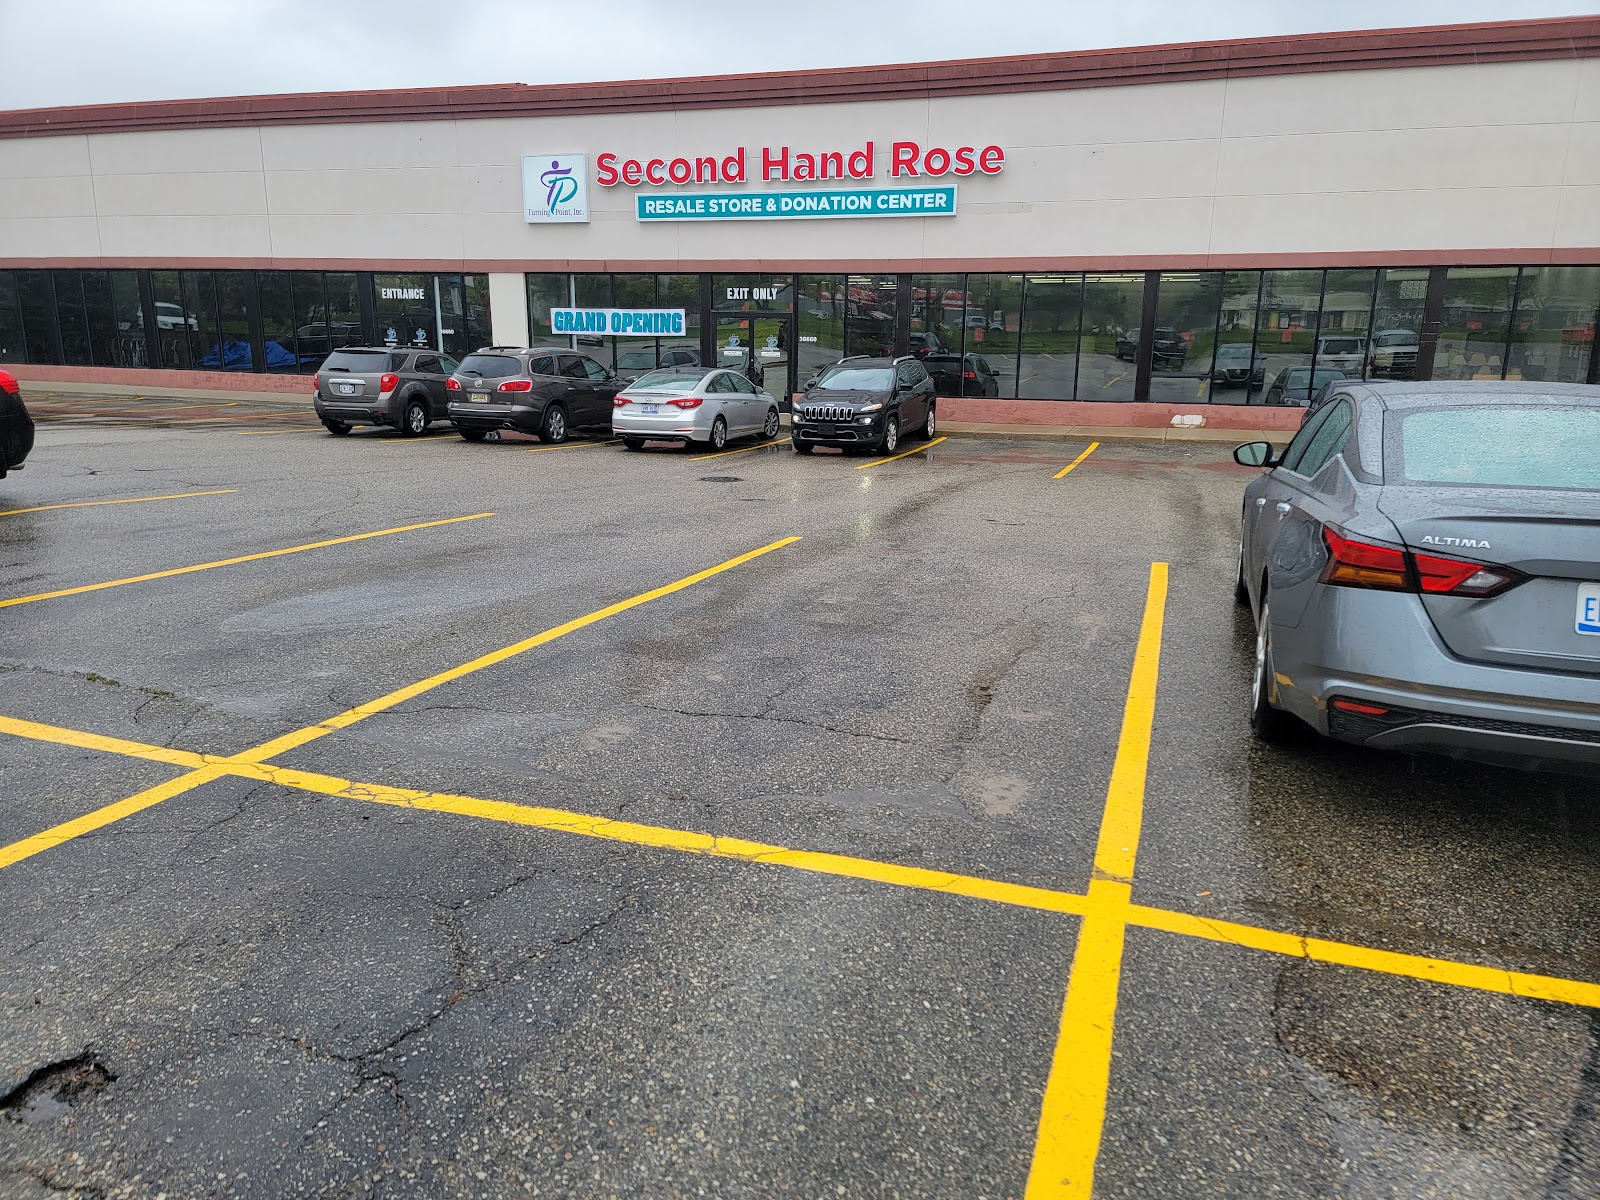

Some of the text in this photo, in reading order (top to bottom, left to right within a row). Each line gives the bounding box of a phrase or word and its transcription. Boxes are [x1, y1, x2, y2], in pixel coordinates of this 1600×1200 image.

[595, 140, 1005, 187] Second Hand Rose
[645, 193, 946, 214] RESALE STORE & DONATION CENTER
[527, 208, 585, 217] Turning Point, Inc.
[381, 288, 425, 300] ENTRANCE
[726, 287, 778, 300] EXIT ONLY
[554, 311, 682, 333] GRAND OPENING
[1421, 535, 1492, 549] ALTIMA
